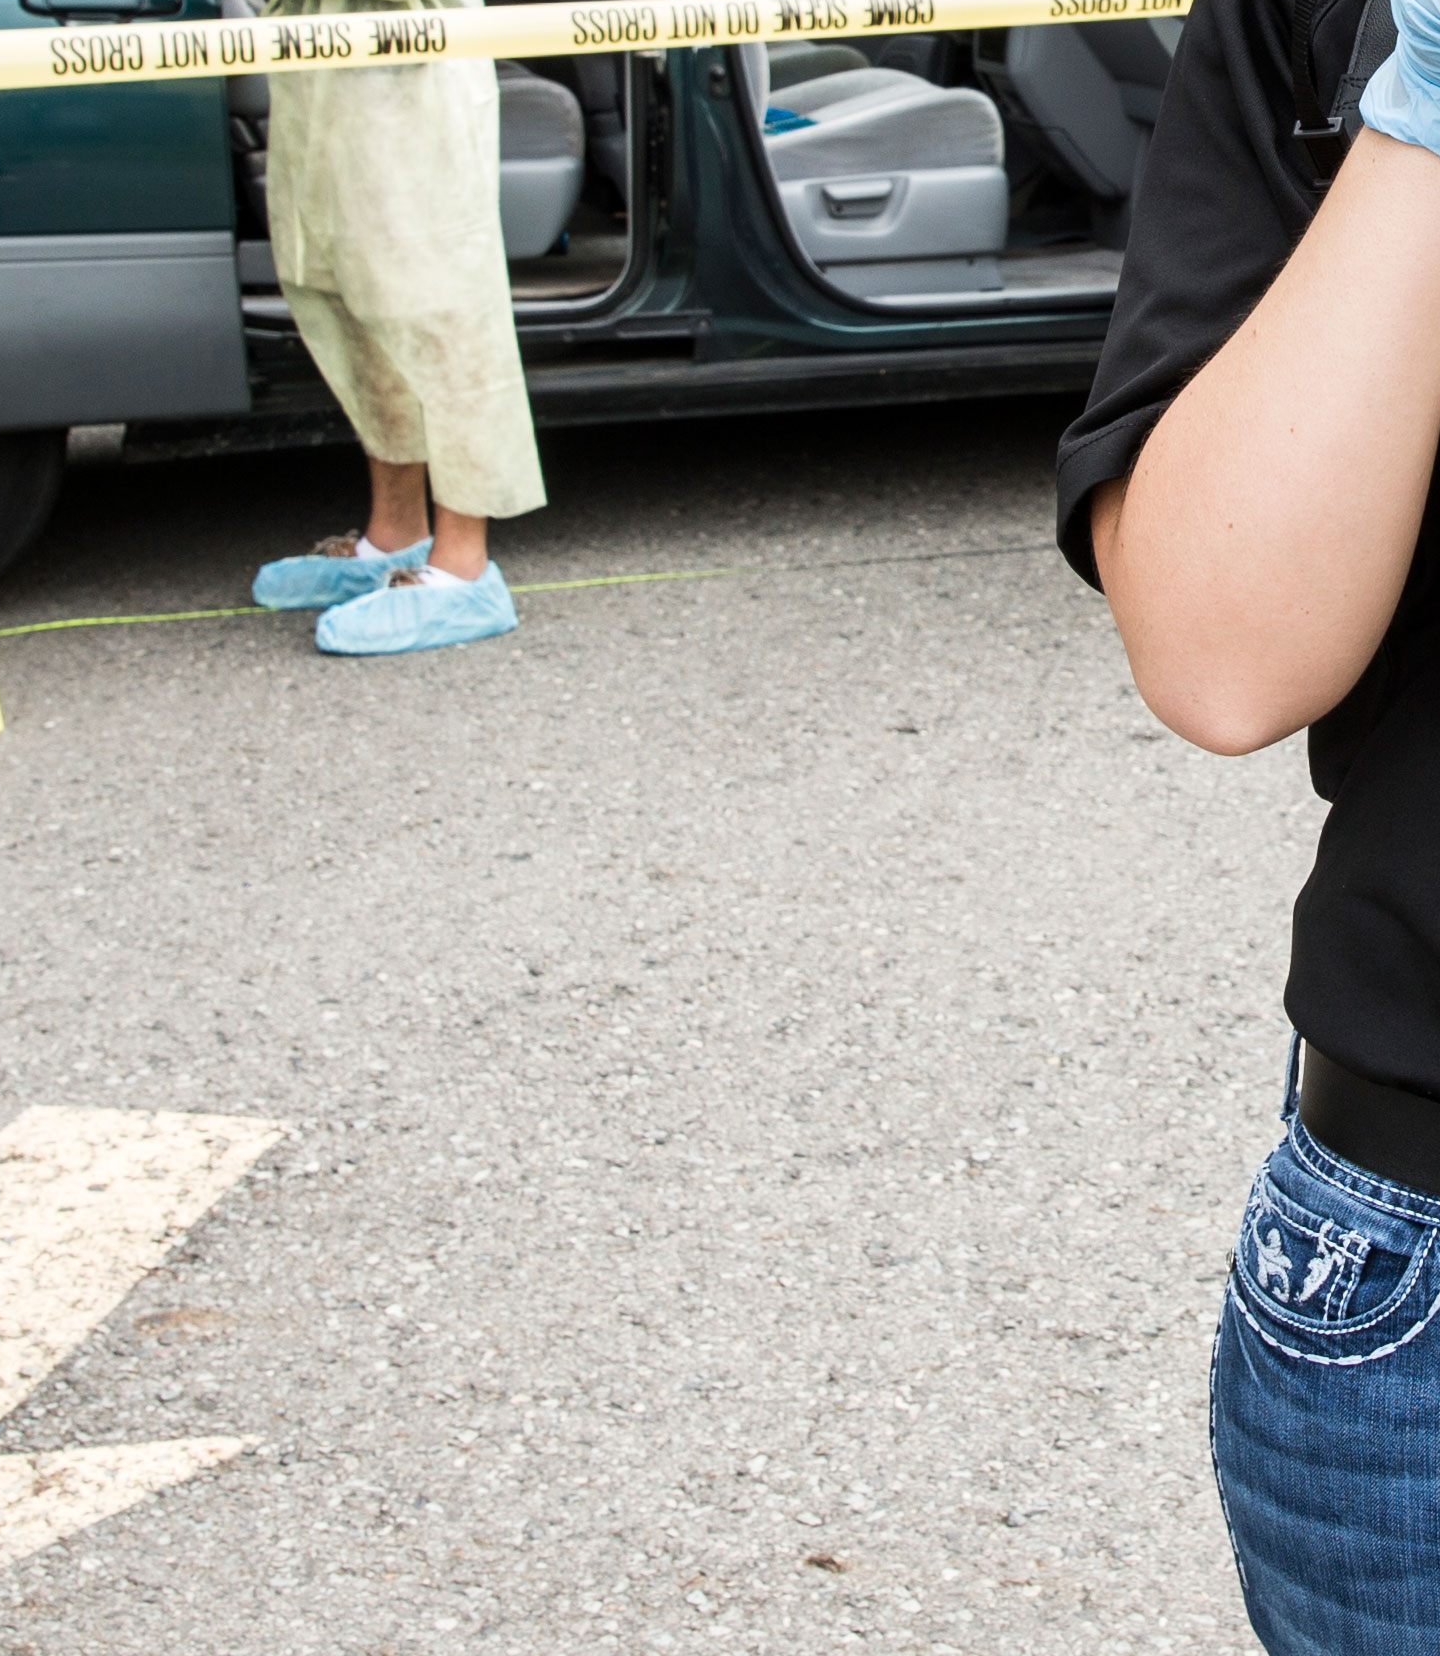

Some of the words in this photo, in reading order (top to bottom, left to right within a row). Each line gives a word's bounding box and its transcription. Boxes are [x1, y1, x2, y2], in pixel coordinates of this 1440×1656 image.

[368, 17, 447, 56] CRIME
[570, 6, 657, 45] CROSS
[667, 3, 717, 40] NOT
[727, 1, 759, 36] DO
[50, 34, 144, 75] CROSS
[155, 29, 209, 70] NOT
[220, 26, 256, 65] DO
[270, 21, 352, 62] SCENE
